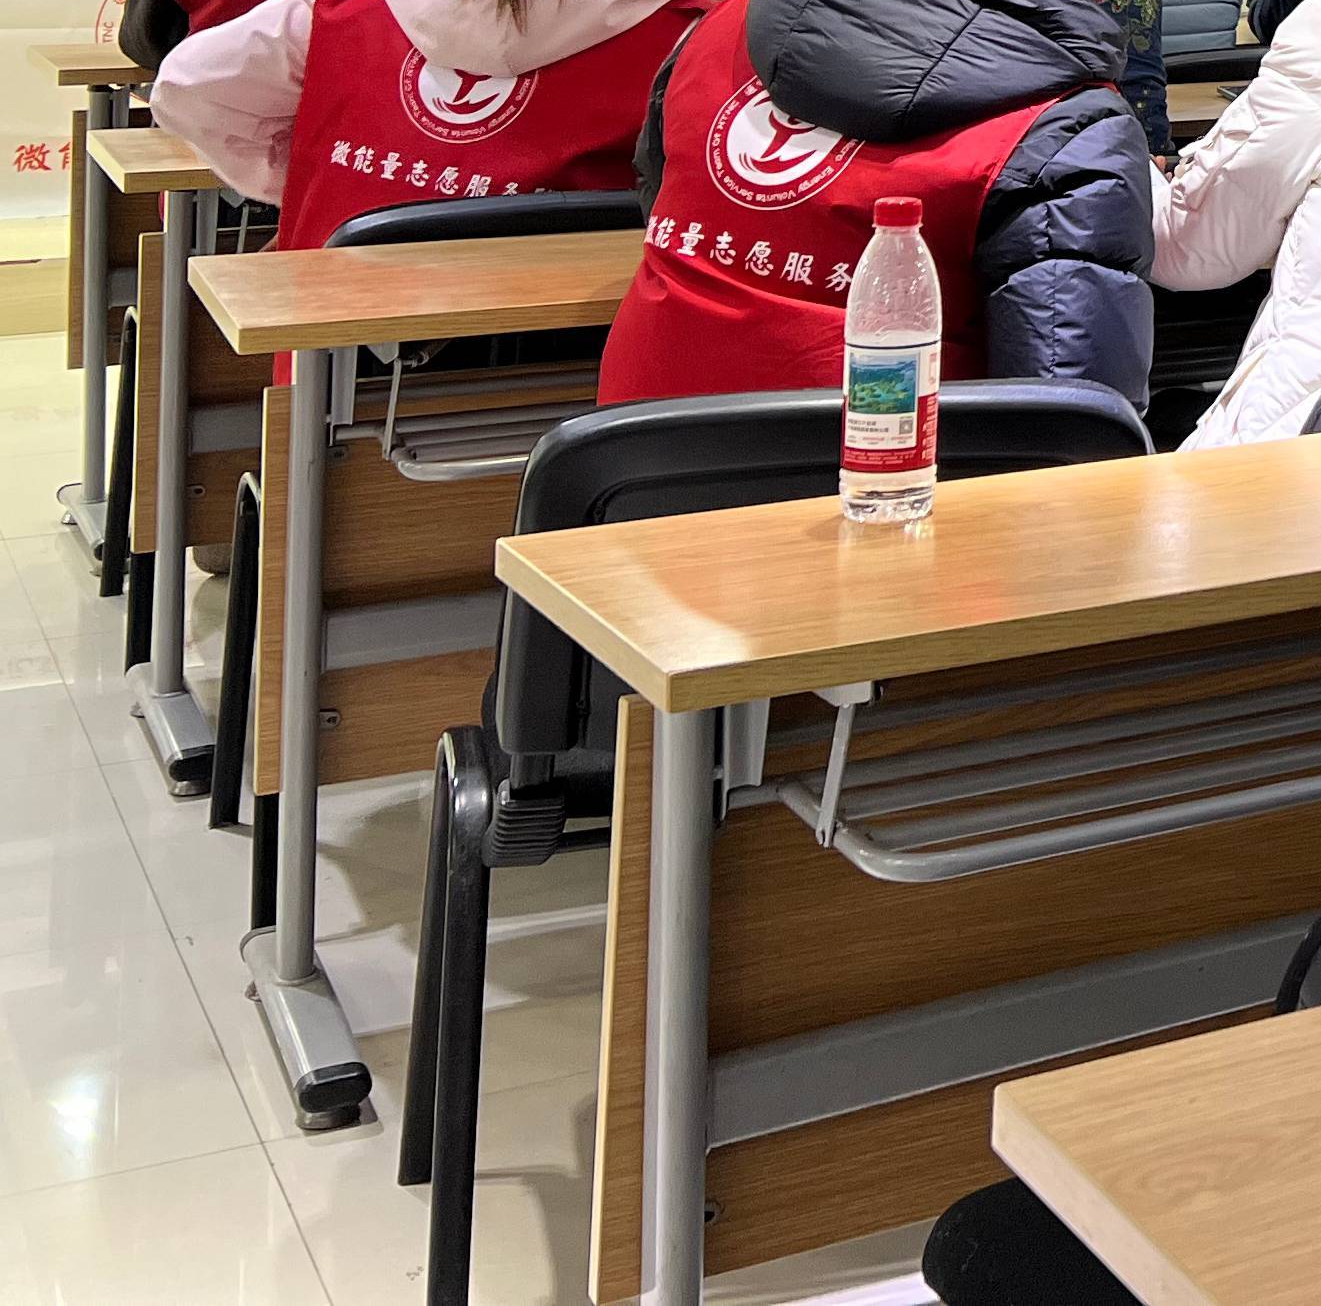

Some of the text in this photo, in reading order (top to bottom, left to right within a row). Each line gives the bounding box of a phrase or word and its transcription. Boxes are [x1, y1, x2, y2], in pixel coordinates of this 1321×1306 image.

[102, 21, 114, 43] TNC
[834, 138, 859, 162] icro
[330, 140, 552, 197] 微能量志愿服务
[723, 176, 754, 201] Service
